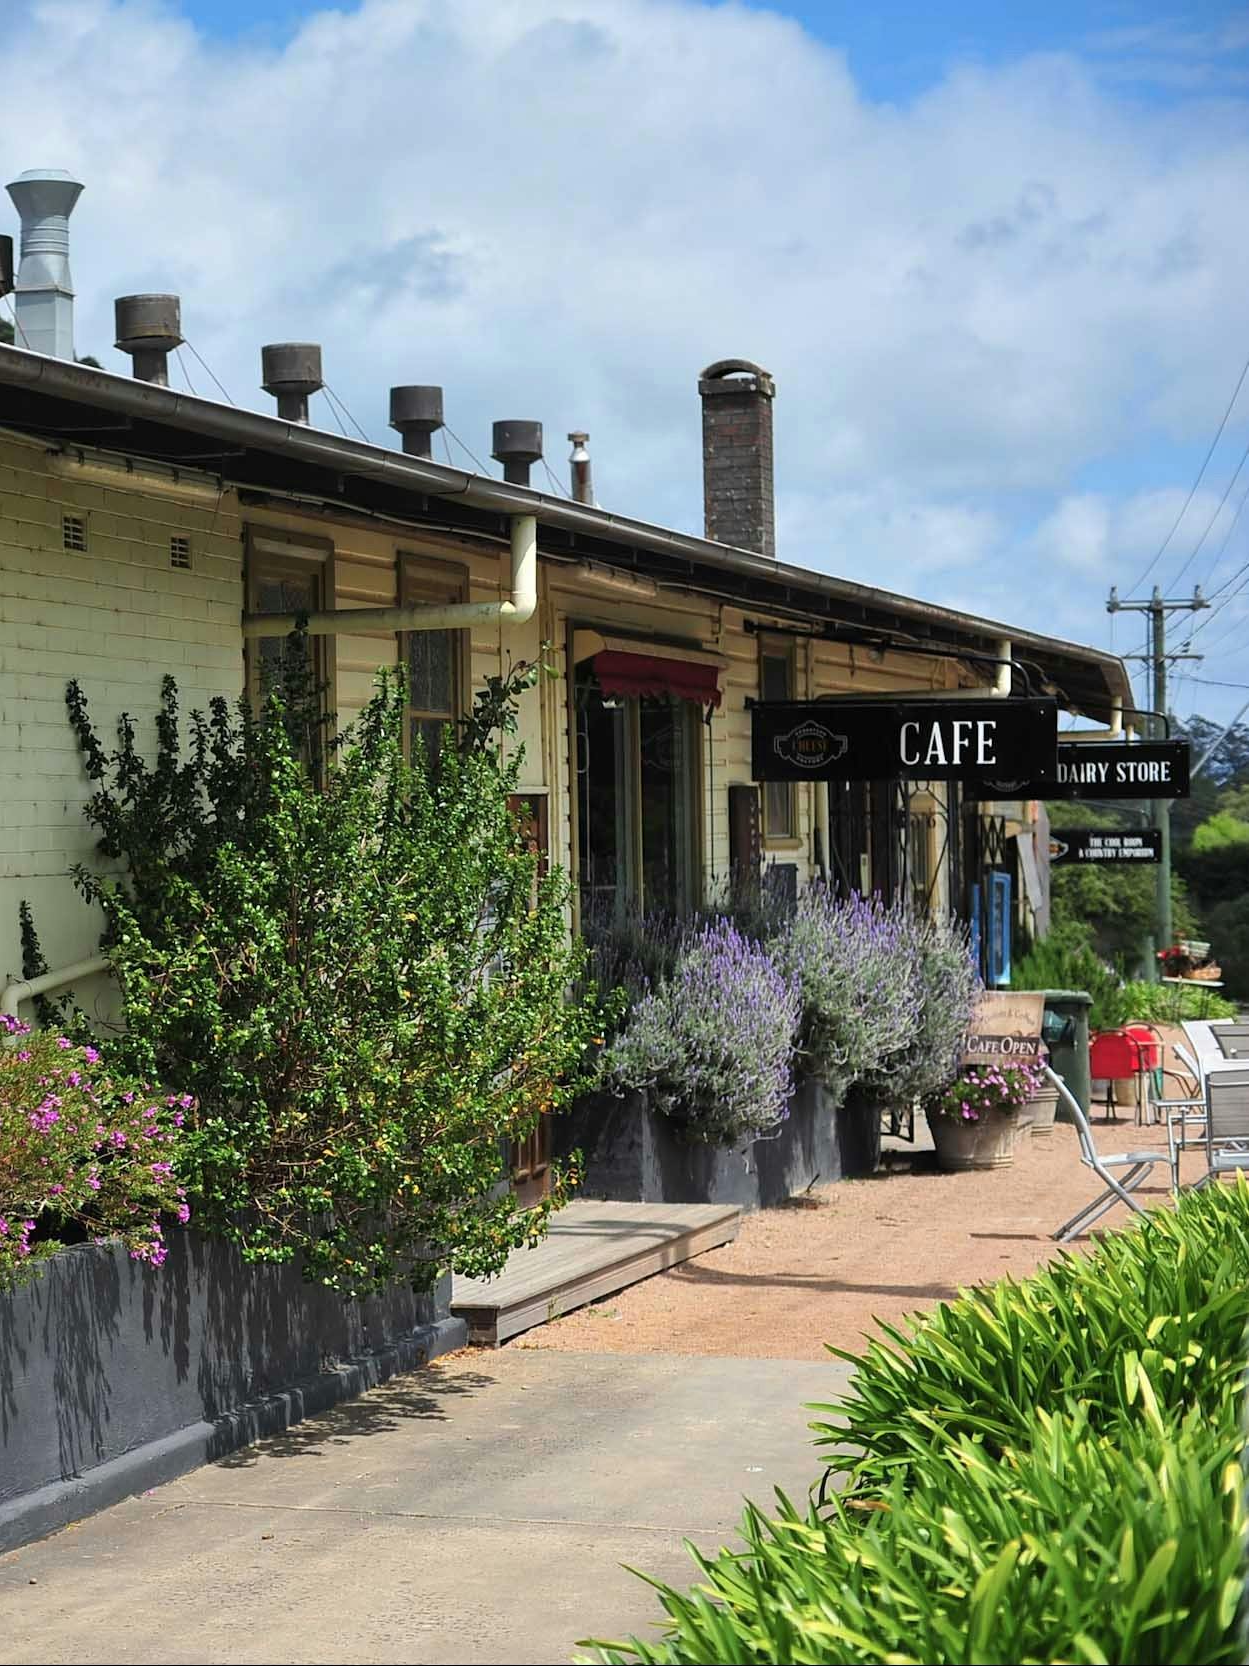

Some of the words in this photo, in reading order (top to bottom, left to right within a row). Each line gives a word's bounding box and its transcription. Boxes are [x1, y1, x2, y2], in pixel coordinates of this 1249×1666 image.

[900, 720, 997, 765] CAFE
[1057, 762, 1109, 783] DAIRY
[1116, 761, 1172, 783] STORE
[967, 1036, 999, 1053] CAFE
[1000, 1036, 1037, 1055] OPEN
